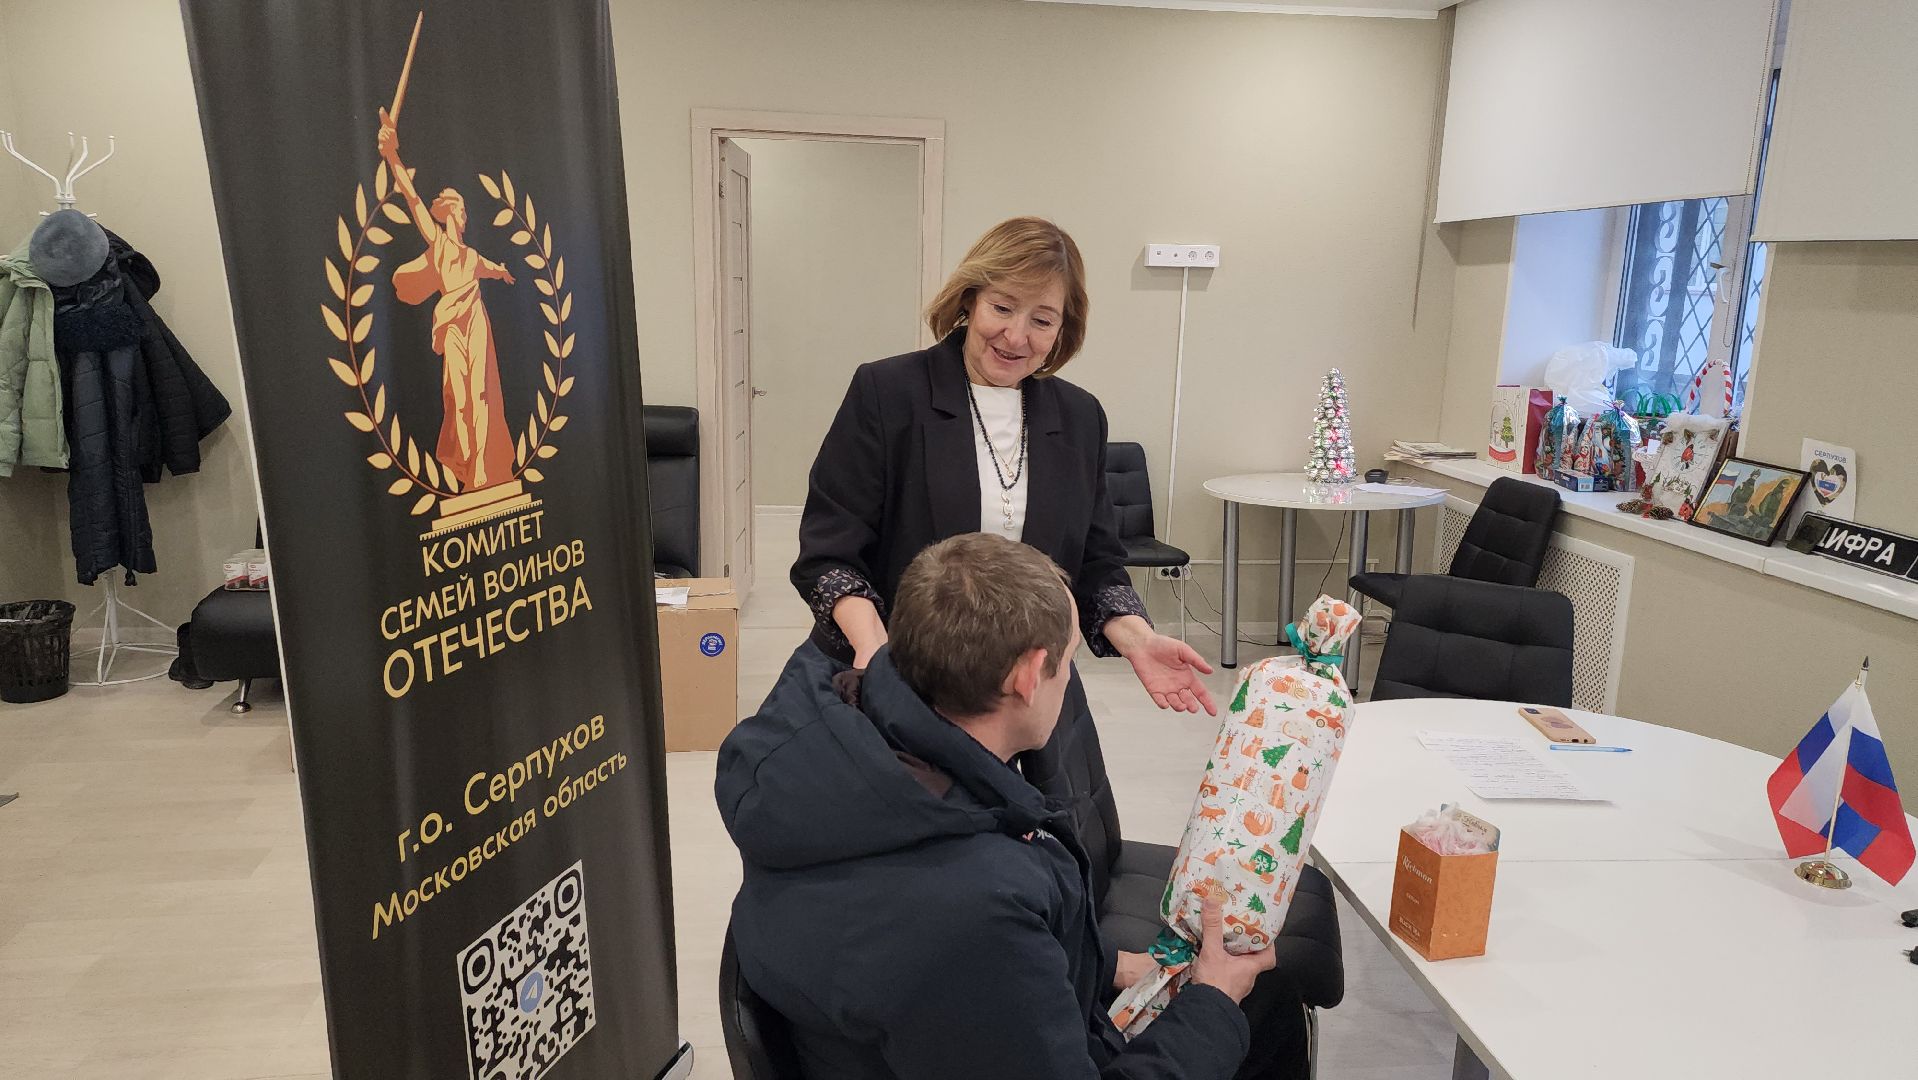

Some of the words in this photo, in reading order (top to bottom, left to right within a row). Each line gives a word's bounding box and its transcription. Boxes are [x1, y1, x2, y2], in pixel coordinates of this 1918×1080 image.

[1814, 449, 1847, 464] СЕРПУХОВ
[380, 573, 476, 641] СЕМЕЙ
[483, 539, 586, 602] ВОИНОВ
[422, 510, 544, 577] КОМИТЕТ
[383, 576, 594, 699] ОТЕЧЕСТВА
[398, 812, 453, 862] г.о.
[464, 714, 606, 816] Серпухов
[372, 809, 538, 941] Московская
[543, 751, 628, 818] область
